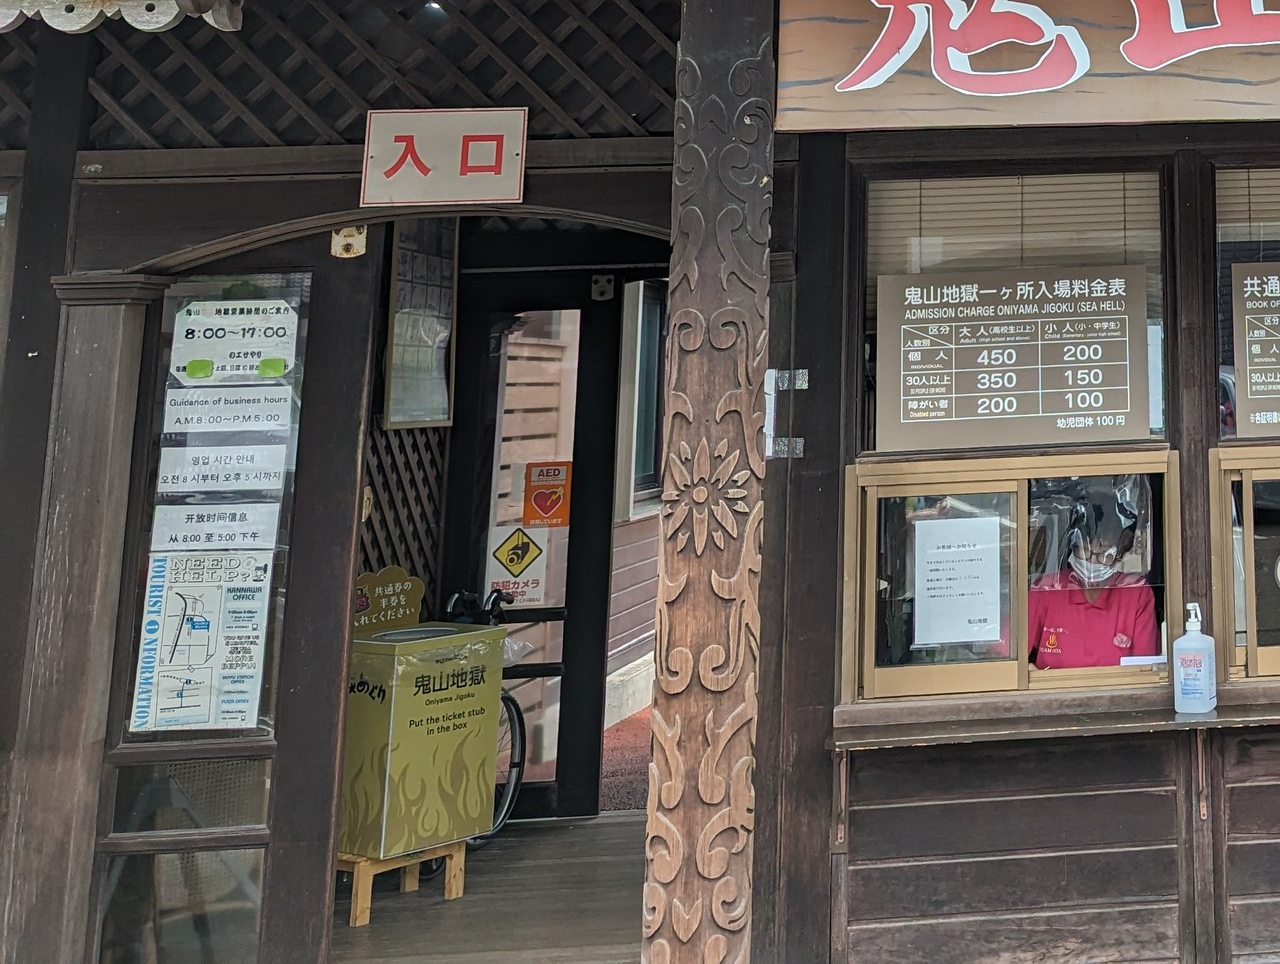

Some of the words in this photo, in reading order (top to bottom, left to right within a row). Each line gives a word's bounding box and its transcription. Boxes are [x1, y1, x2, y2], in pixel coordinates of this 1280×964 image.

[383, 134, 504, 179] 入口
[904, 307, 955, 320] ADMISSION
[957, 305, 995, 317] CHARGE
[997, 303, 1039, 316] ONIYAMA
[1041, 302, 1075, 314] JIGOKU
[1077, 301, 1098, 313] (SEA
[1100, 300, 1125, 312] HELL)
[1246, 300, 1269, 309] BOOK
[1270, 299, 1280, 308] OF
[1264, 316, 1279, 325] 区分
[928, 325, 950, 335] 区分
[976, 348, 1017, 366] 450
[1063, 344, 1102, 361] 200
[906, 374, 951, 386] 30人以上
[977, 371, 1017, 389] 350
[1064, 369, 1103, 386] 150
[169, 398, 209, 407] Guidance
[212, 397, 222, 405] of
[223, 396, 261, 405] business
[264, 395, 288, 404] hours
[907, 399, 949, 410] 障がい者
[977, 396, 1017, 414] 200
[1064, 392, 1103, 409] 100
[191, 455, 210, 466] 영업
[213, 455, 233, 465] 시간
[235, 454, 255, 465] 안내
[160, 475, 179, 485] 오전
[190, 473, 219, 484] 시부터
[222, 472, 242, 482] 오후
[245, 473, 250, 481] 5
[252, 471, 281, 481] 시까지
[537, 468, 561, 478] AED
[184, 512, 248, 524] 开放时间信息
[168, 534, 179, 543] 从
[182, 534, 201, 543] 8:00
[203, 533, 214, 543] 至
[217, 533, 236, 542] 5:00
[239, 532, 260, 542] 下午
[170, 556, 241, 571] NEED
[169, 570, 251, 583] HELP?
[147, 556, 168, 616] TOURIST
[226, 586, 263, 594] KANNAWA
[375, 581, 412, 596] 共通券の
[380, 594, 407, 608] 半券を
[225, 655, 254, 663] MORE
[413, 664, 487, 696] 鬼山地獄
[425, 696, 453, 706] Oniyama
[454, 692, 476, 701] Jigoku
[409, 719, 424, 728] Put
[426, 716, 440, 725] the
[442, 711, 466, 722] ticket
[467, 706, 486, 717] stub
[426, 727, 435, 736] in
[437, 724, 450, 734] the
[452, 722, 468, 731] box
